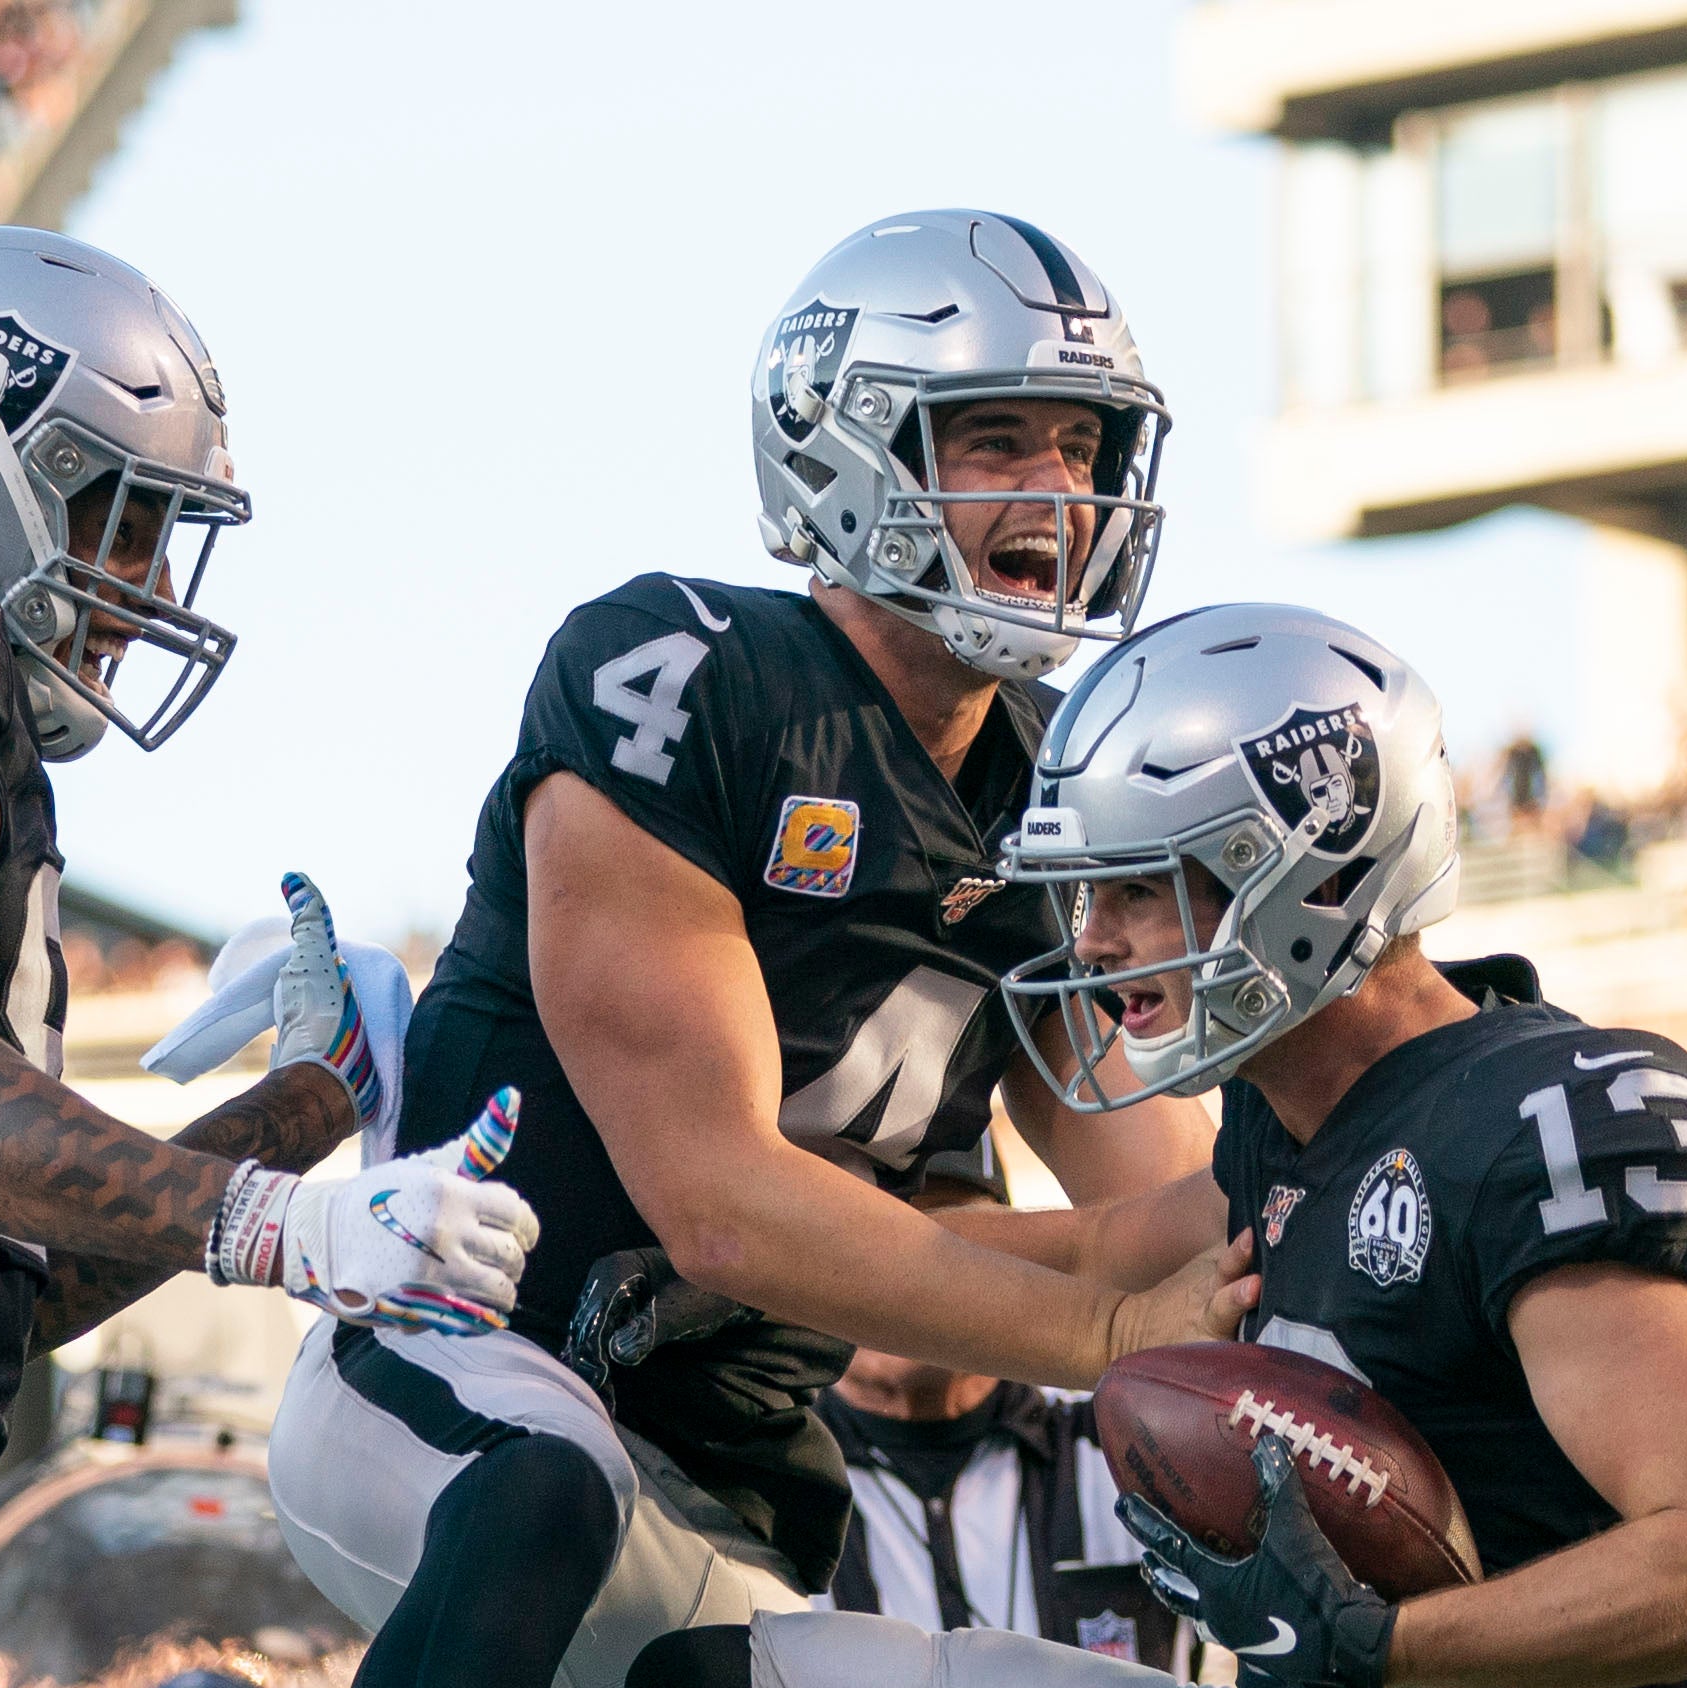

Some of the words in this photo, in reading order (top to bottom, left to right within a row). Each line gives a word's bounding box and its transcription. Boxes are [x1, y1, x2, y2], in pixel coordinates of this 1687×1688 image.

[780, 311, 848, 335] RAIDERS
[1058, 350, 1115, 370] RAIDERS
[593, 630, 711, 787] 4
[1254, 708, 1357, 759] RAIDERS
[781, 803, 856, 871] C
[1026, 820, 1062, 836] RAIDERS
[777, 963, 990, 1187] 4
[226, 1180, 260, 1232] HUMBLE
[1359, 1178, 1419, 1250] 60
[255, 1237, 274, 1281] YOUNG
